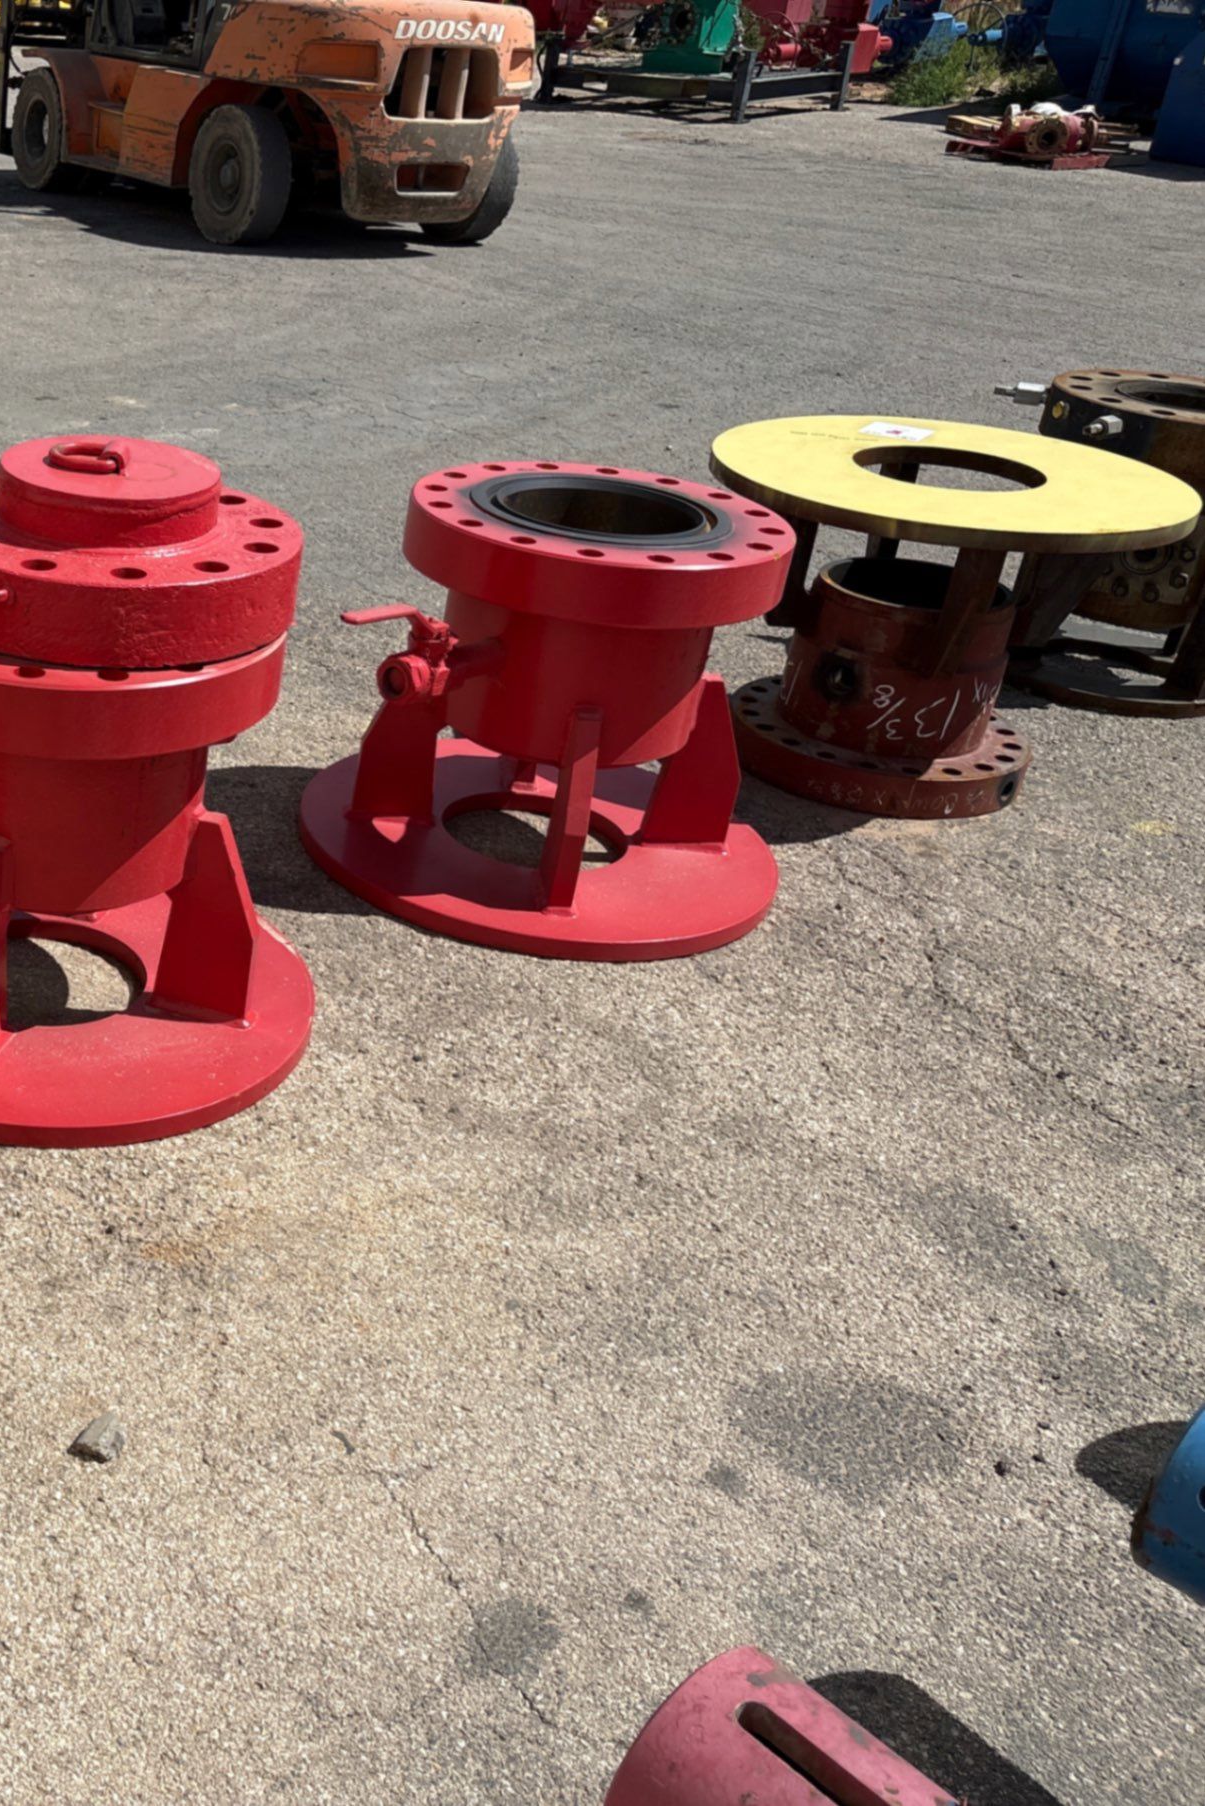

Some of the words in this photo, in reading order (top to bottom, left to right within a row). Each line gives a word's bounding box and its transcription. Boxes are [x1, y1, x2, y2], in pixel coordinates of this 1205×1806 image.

[395, 19, 505, 43] DOOSAN
[866, 684, 907, 740] 3/8
[913, 688, 961, 740] 13
